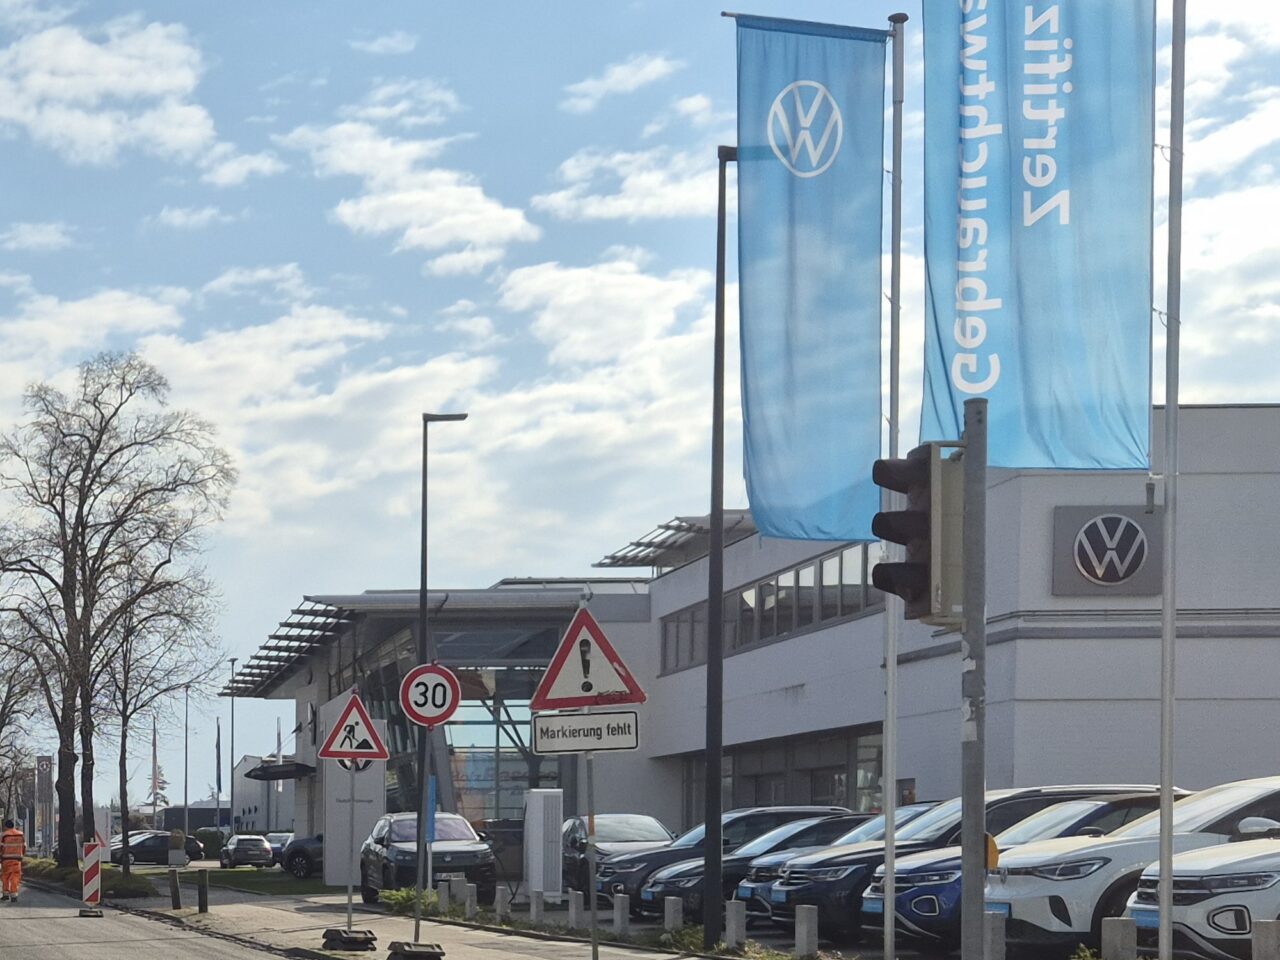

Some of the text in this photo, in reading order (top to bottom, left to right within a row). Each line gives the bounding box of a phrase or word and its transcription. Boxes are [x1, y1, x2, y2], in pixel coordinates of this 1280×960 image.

[413, 681, 447, 709] 30
[540, 722, 632, 740] Markierung fehlt
